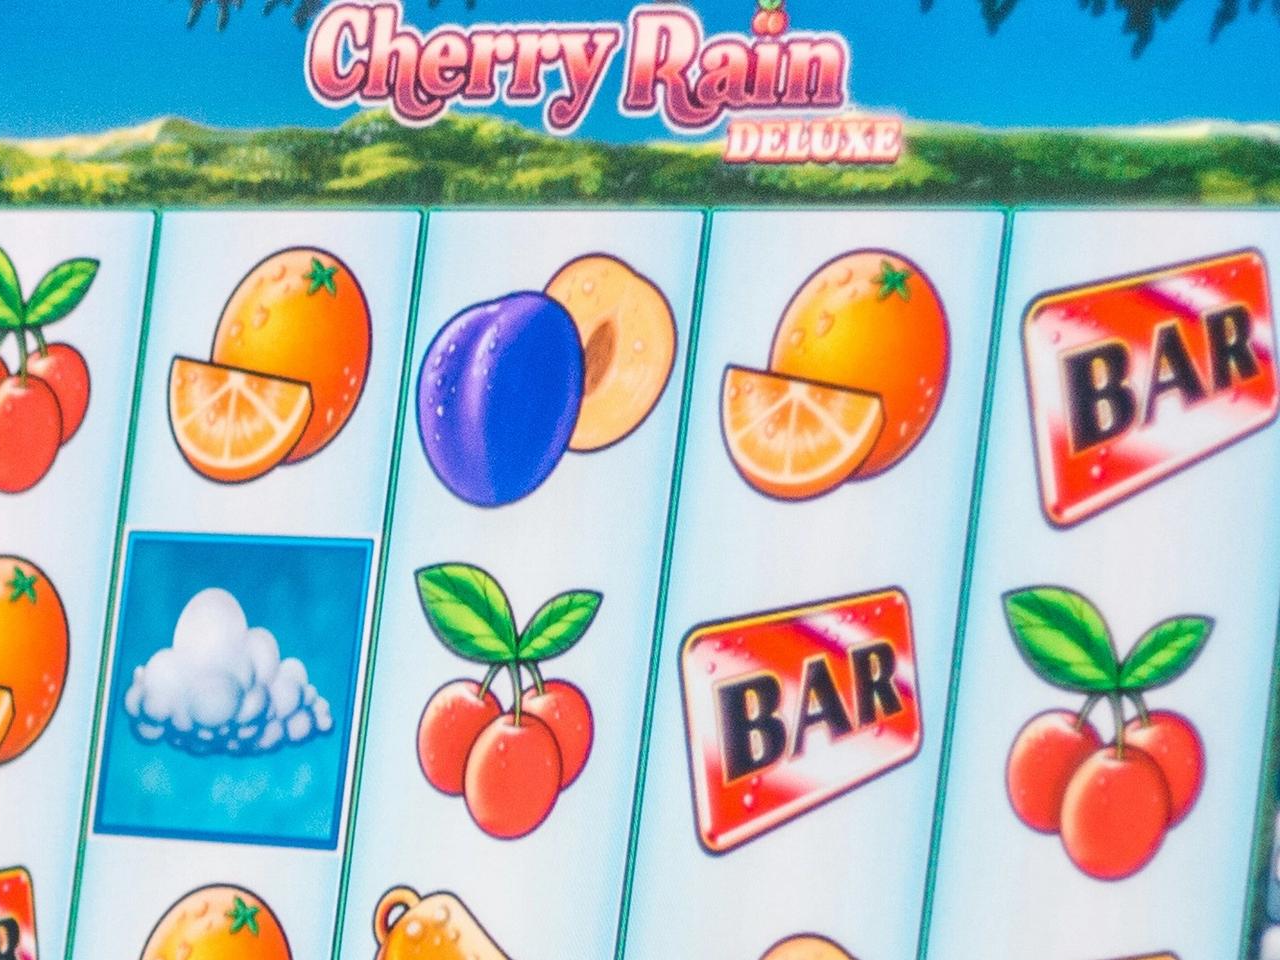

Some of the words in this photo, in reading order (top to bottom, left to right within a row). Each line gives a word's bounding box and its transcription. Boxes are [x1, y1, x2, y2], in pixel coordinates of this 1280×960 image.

[308, 0, 618, 130] Cherry
[624, 8, 846, 128] Rain
[724, 119, 902, 164] DELUXE
[1064, 303, 1260, 454] BAR
[715, 640, 903, 784] BAR
